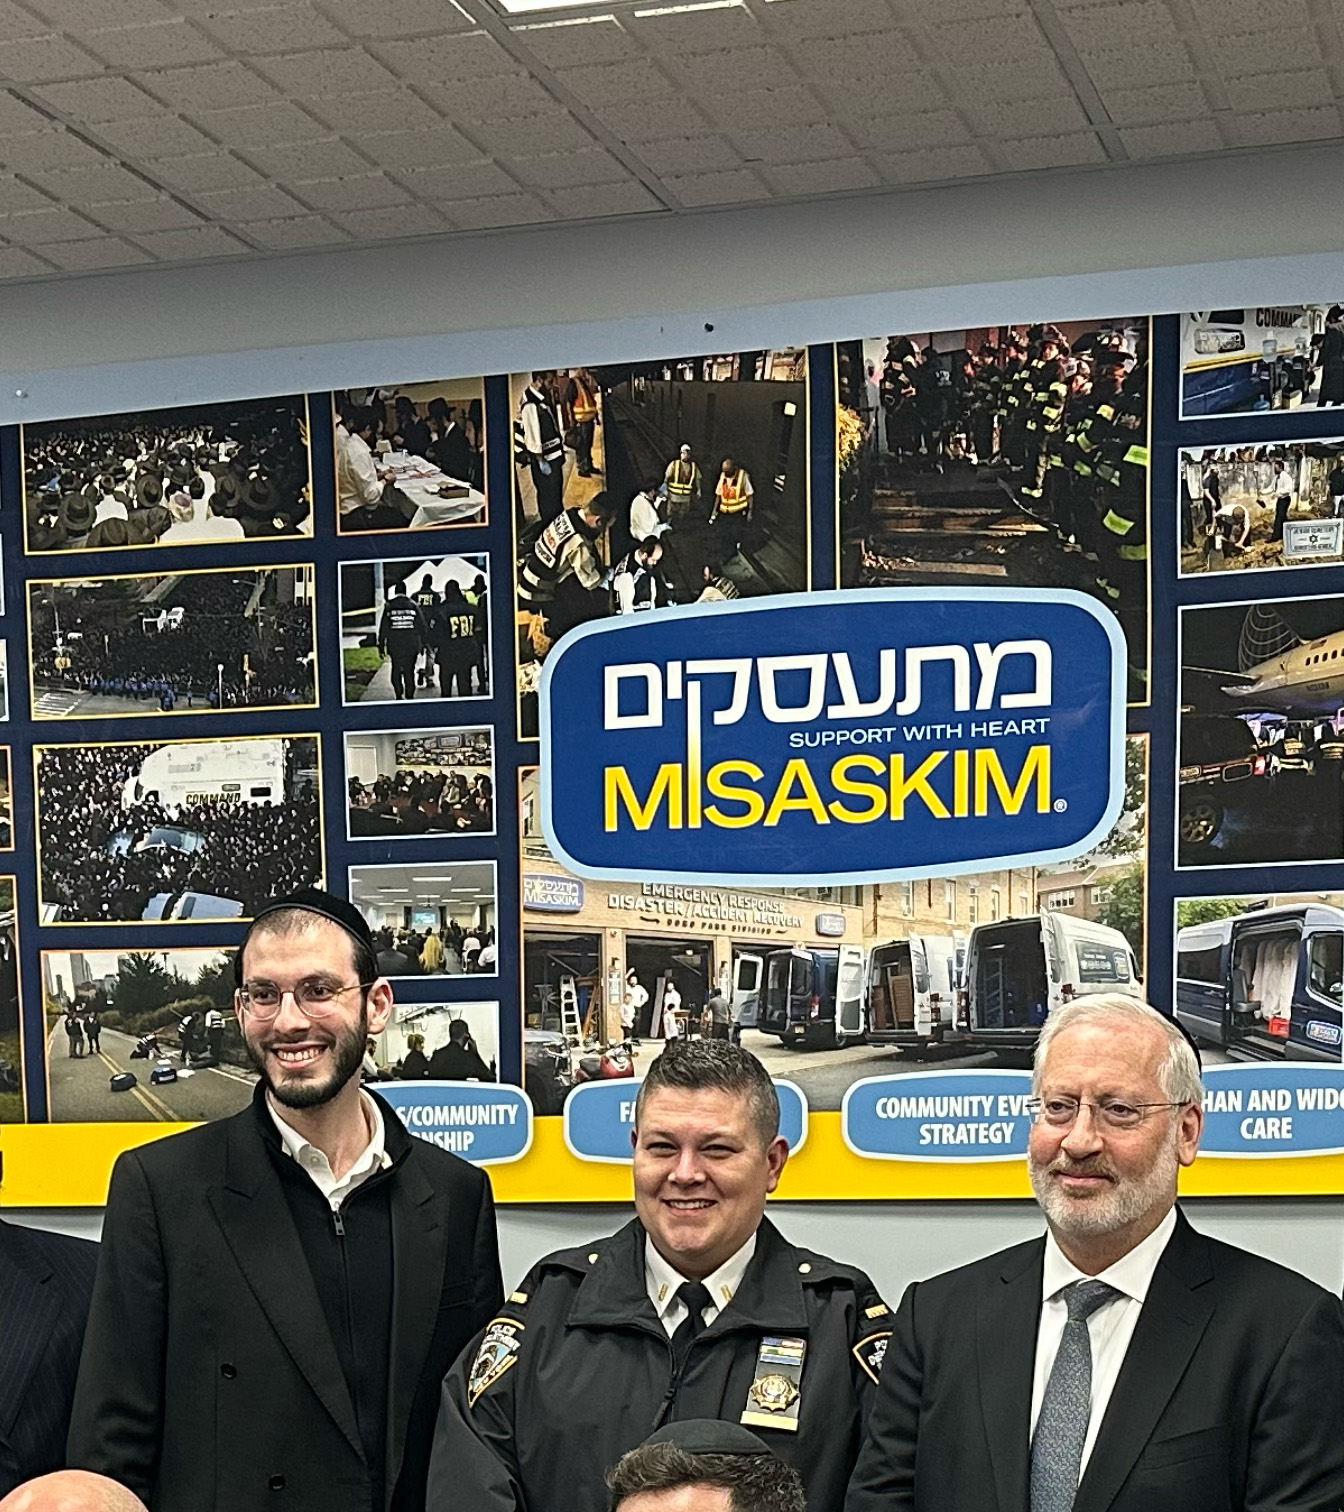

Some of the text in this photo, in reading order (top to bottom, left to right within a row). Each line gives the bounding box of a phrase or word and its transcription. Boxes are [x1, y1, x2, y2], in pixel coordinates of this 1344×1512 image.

[449, 615, 475, 639] FBI
[603, 638, 1053, 730] מתעסקים
[789, 717, 1050, 748] SUPPORT WITH HEART
[641, 882, 785, 914] EMERGENCY RESPONSE
[875, 1095, 994, 1120] COMMUNITY
[1248, 1088, 1293, 1112] AND
[919, 1122, 1016, 1146] STRATEGY
[1240, 1117, 1293, 1140] CARE
